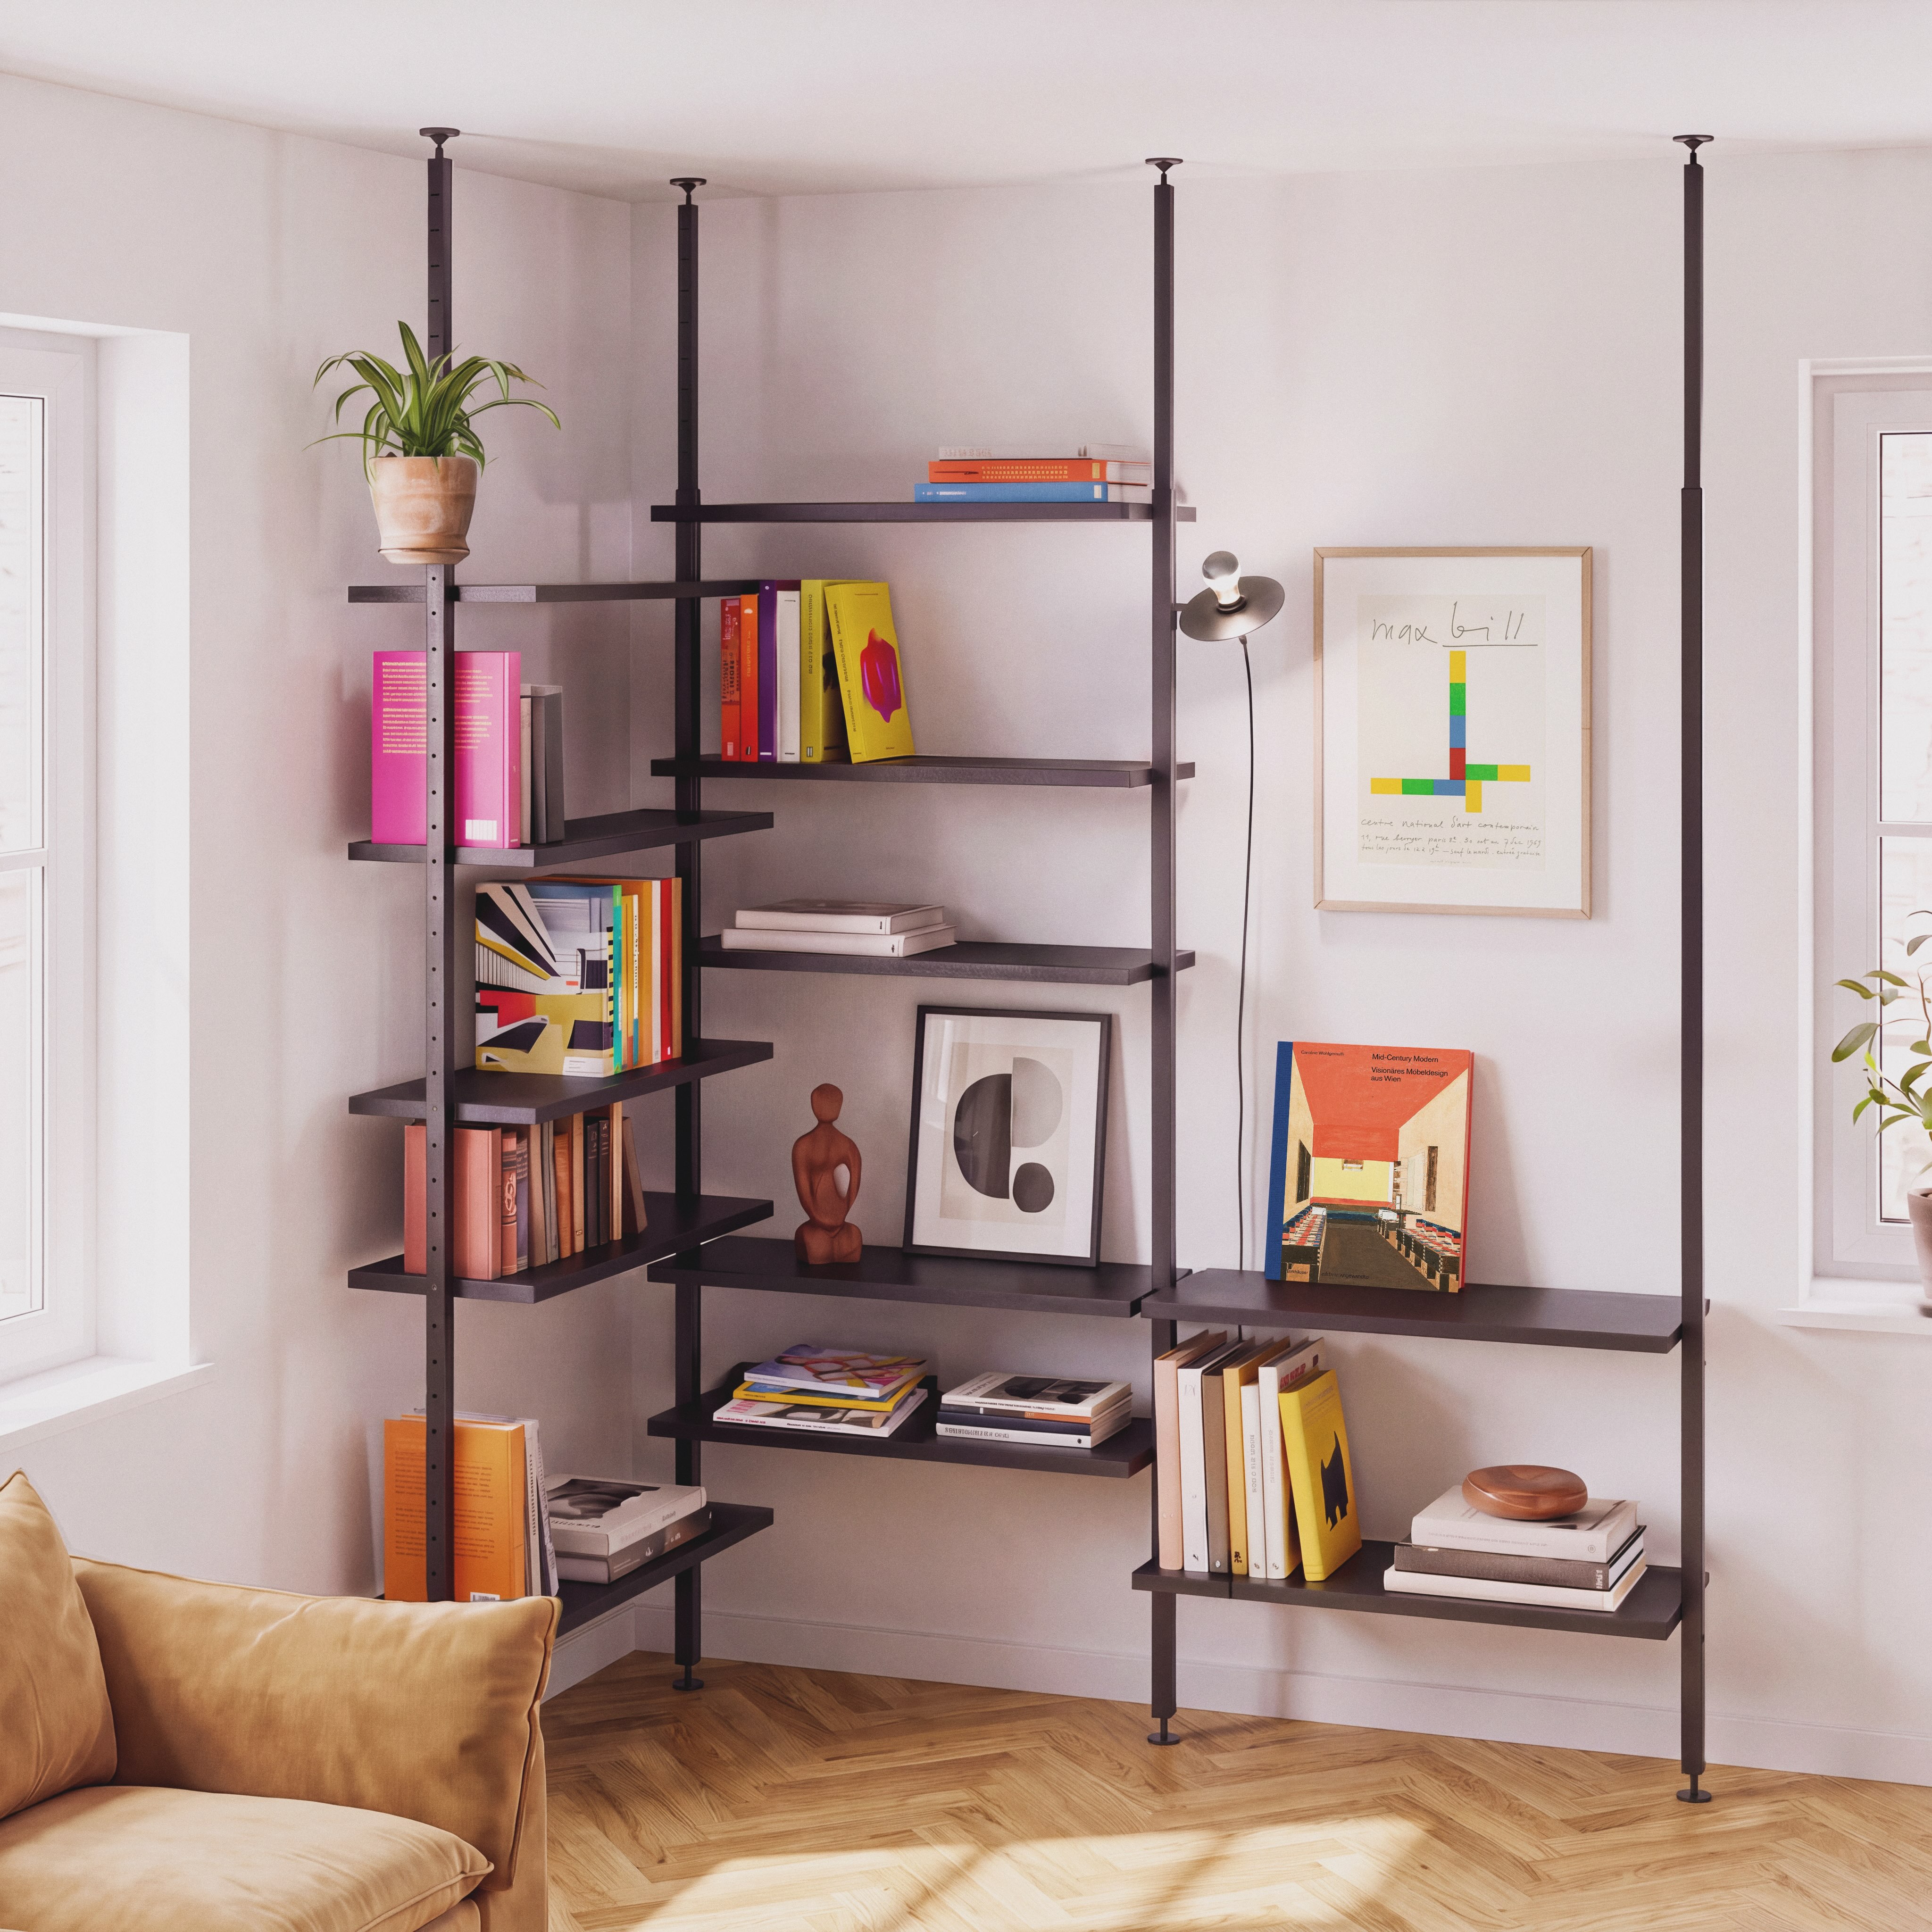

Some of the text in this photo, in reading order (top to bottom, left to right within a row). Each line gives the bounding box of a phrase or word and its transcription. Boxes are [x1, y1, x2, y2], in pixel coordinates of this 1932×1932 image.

[1372, 601, 1524, 645] max bill
[1402, 820, 1444, 828] national
[1478, 821, 1539, 832] contemporain
[1386, 844, 1401, 854] jours
[1516, 850, 1541, 859] gratuite
[1372, 1054, 1412, 1063] Mid-Century
[1406, 1068, 1448, 1077] Möbeldesign
